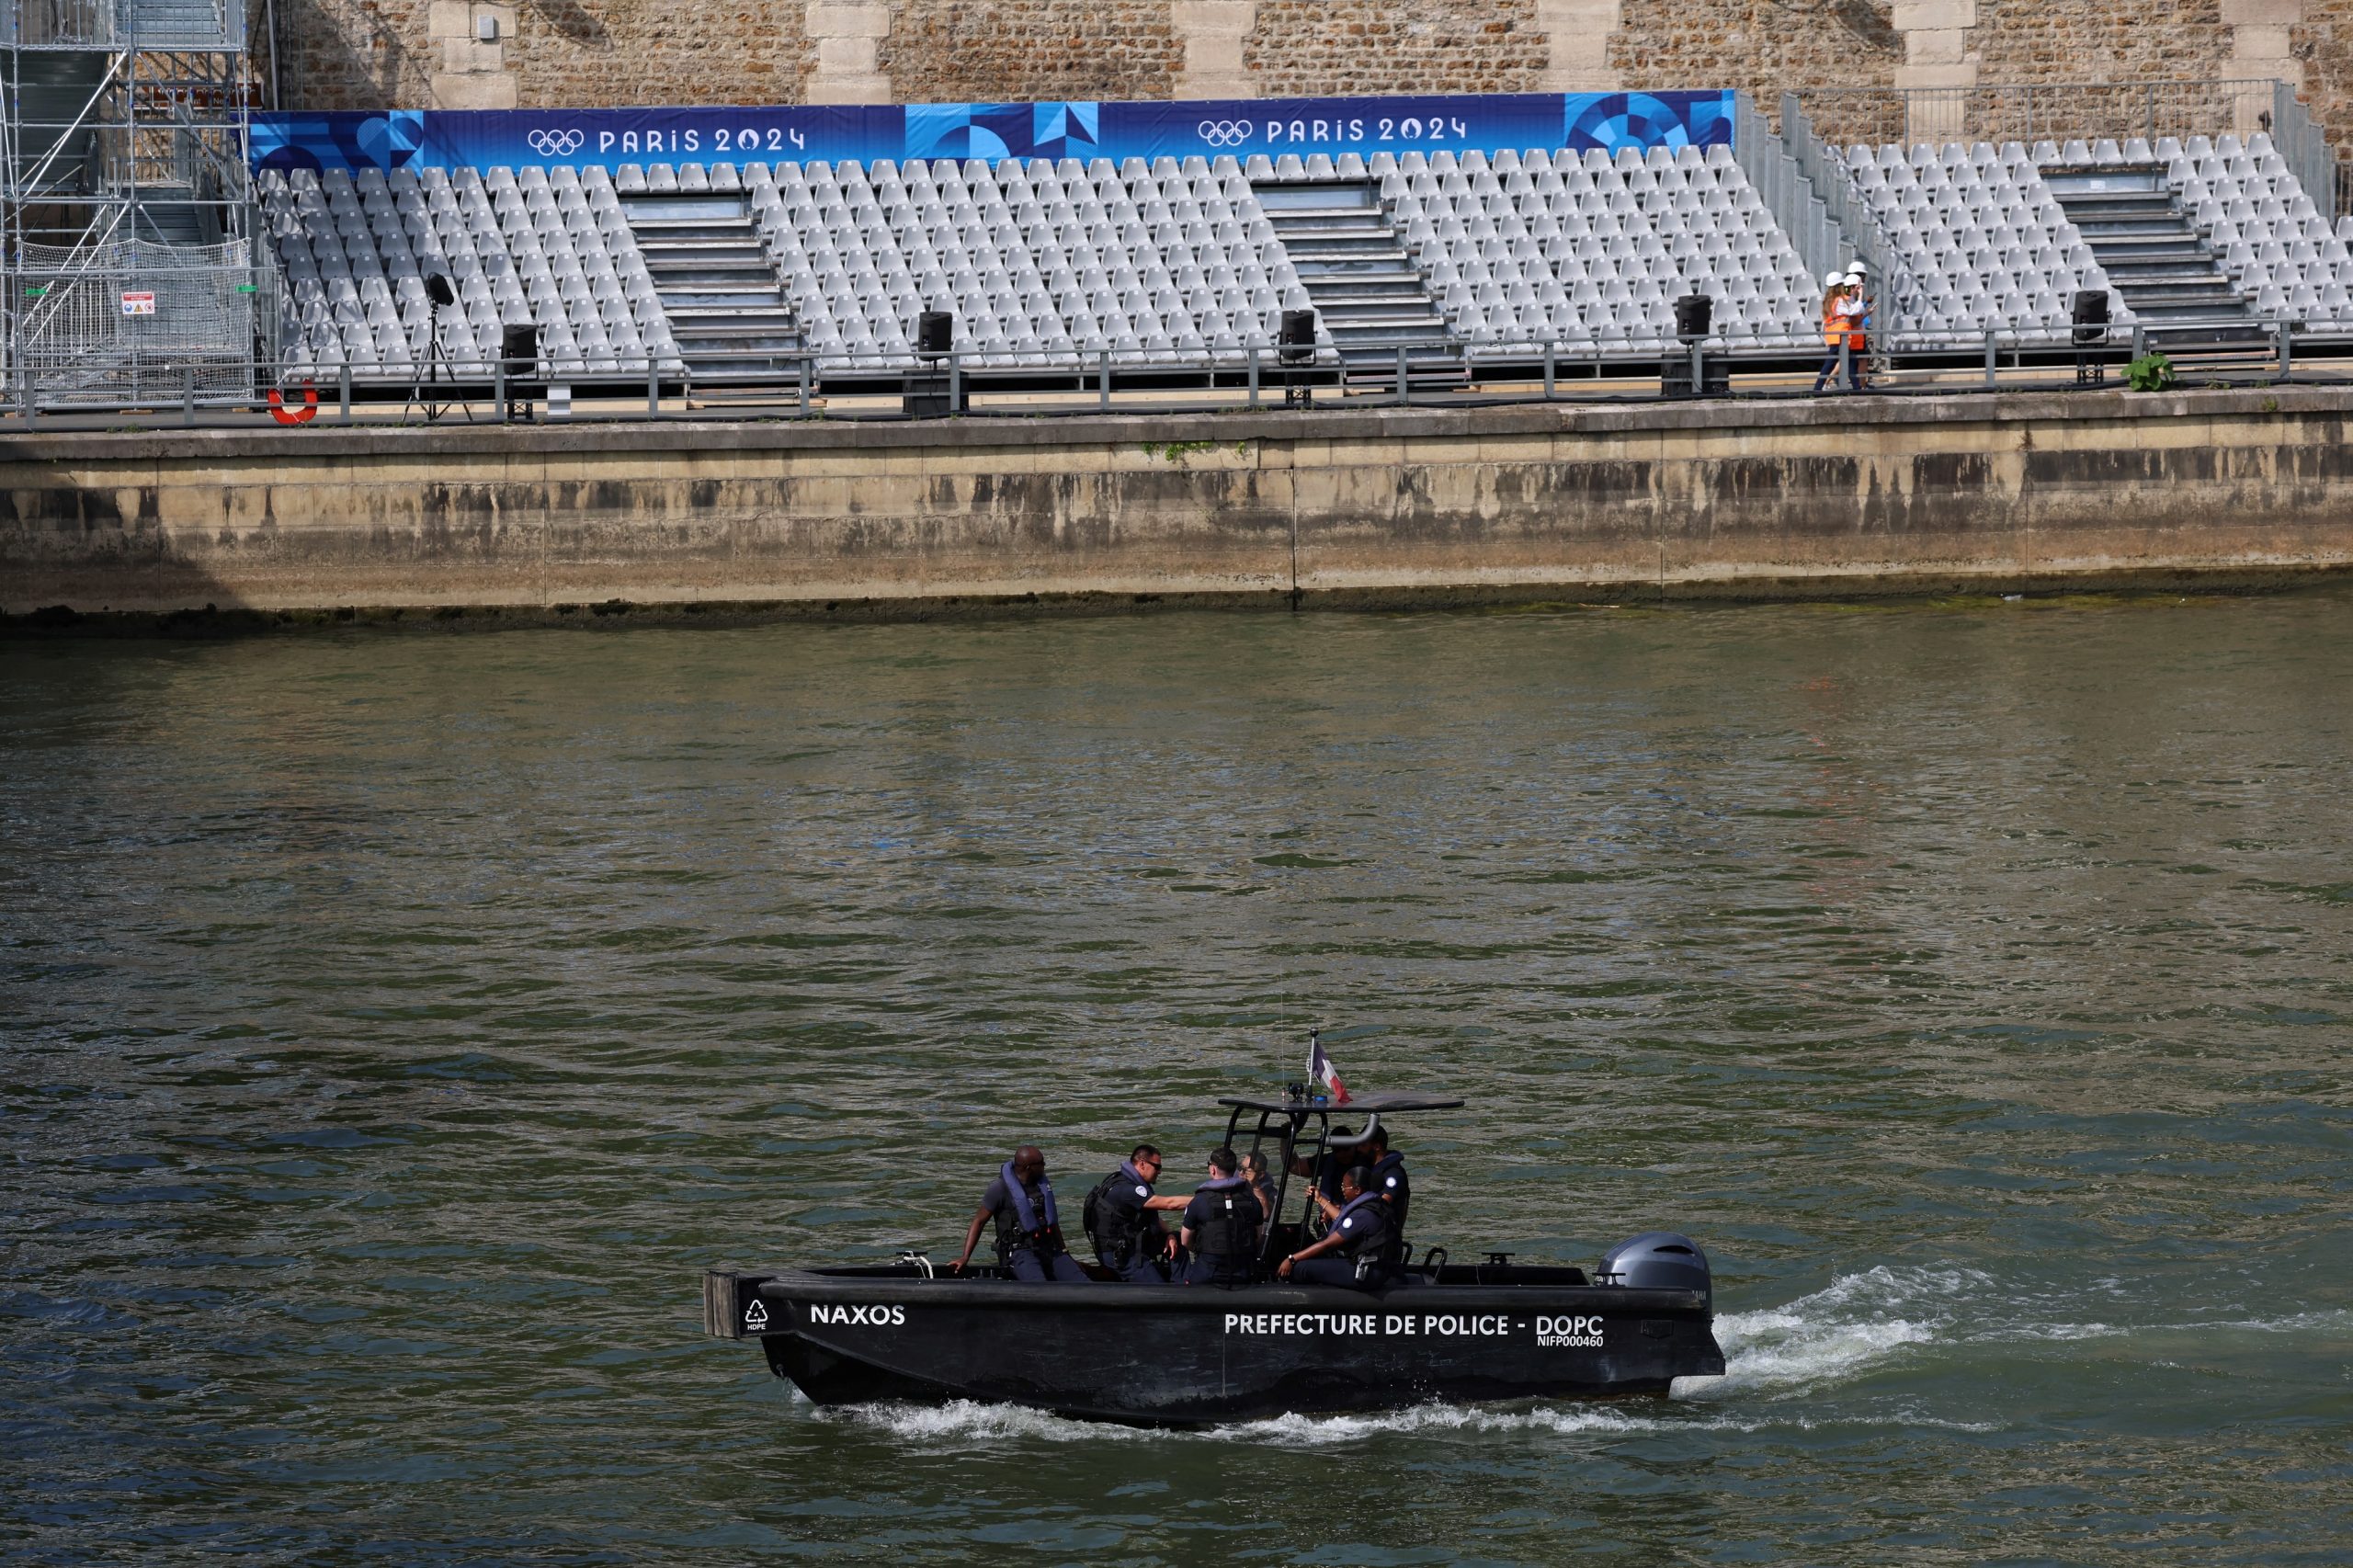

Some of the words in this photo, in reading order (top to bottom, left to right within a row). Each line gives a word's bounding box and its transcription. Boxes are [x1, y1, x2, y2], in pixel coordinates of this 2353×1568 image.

[1379, 117, 1466, 140] 2024
[715, 128, 804, 151] 2024
[810, 1304, 905, 1325] NAXOS
[1224, 1313, 1377, 1335] PREFECTURE
[1385, 1314, 1416, 1335] DE
[1425, 1314, 1509, 1335] POLICE
[1536, 1315, 1604, 1335] DOPC
[746, 1323, 767, 1331] HDPE
[1537, 1335, 1604, 1347] NIFP000460
